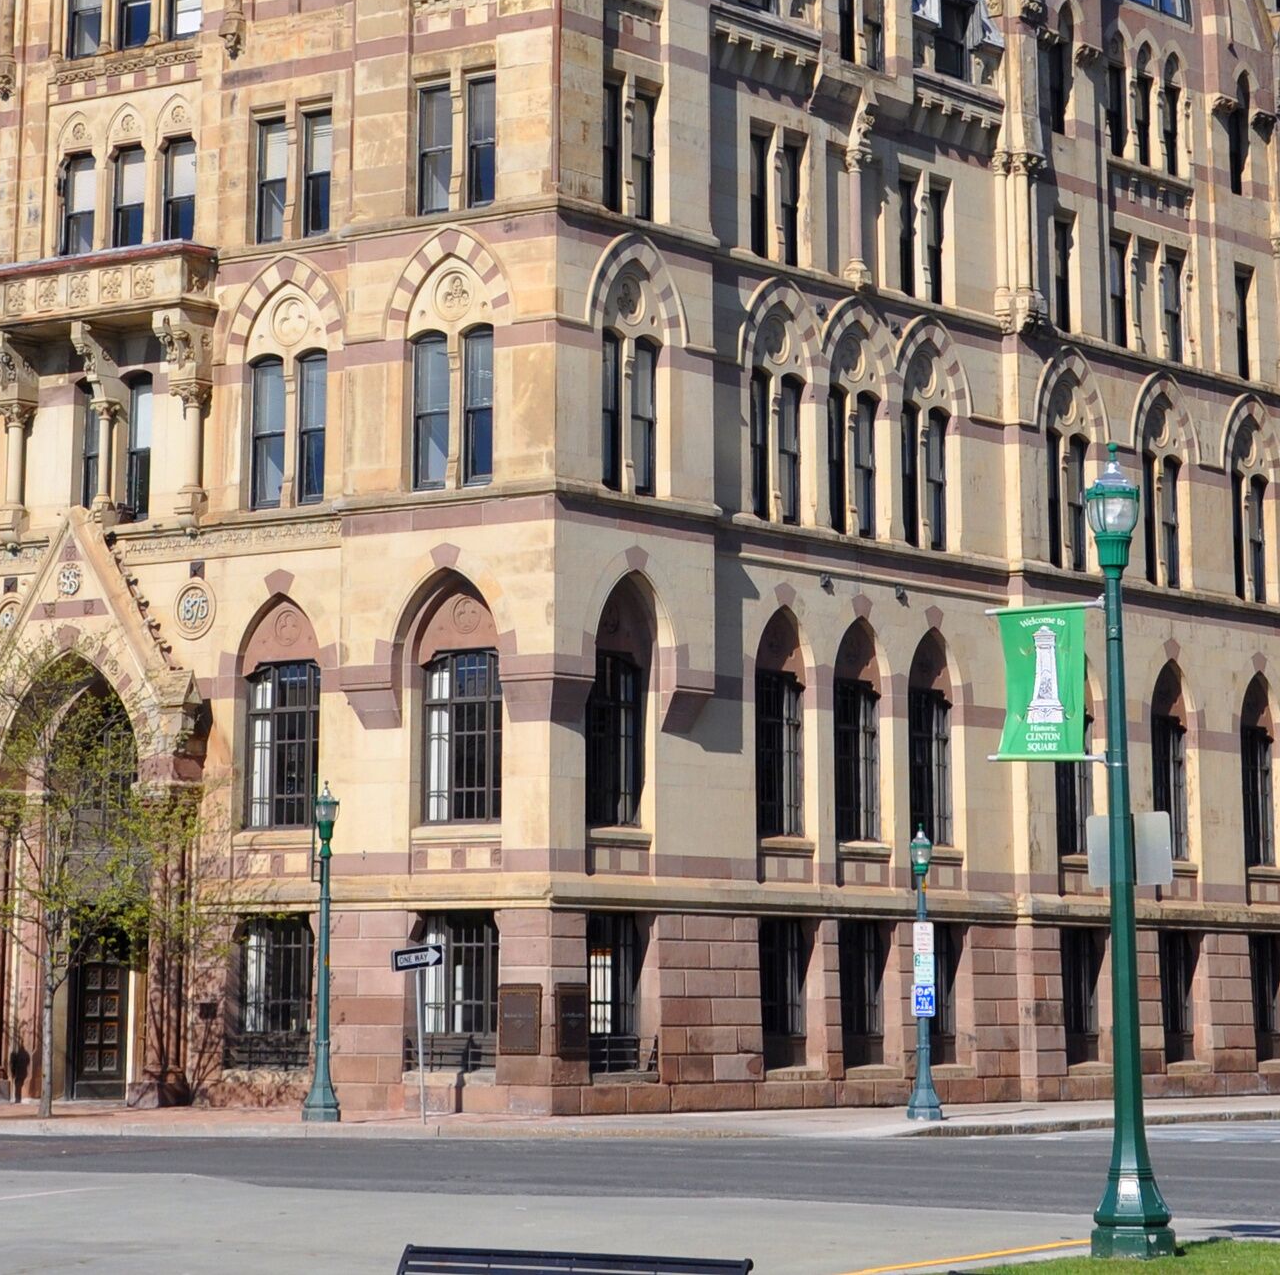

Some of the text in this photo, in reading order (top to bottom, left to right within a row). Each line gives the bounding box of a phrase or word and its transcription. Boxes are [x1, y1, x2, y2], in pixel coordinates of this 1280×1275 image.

[181, 596, 209, 624] 1875
[1019, 616, 1066, 628] Welcome to
[1029, 724, 1057, 732] Historic
[1025, 732, 1061, 742] CLINTON
[1026, 742, 1058, 752] SQUARE
[399, 953, 428, 965] ONE WAY
